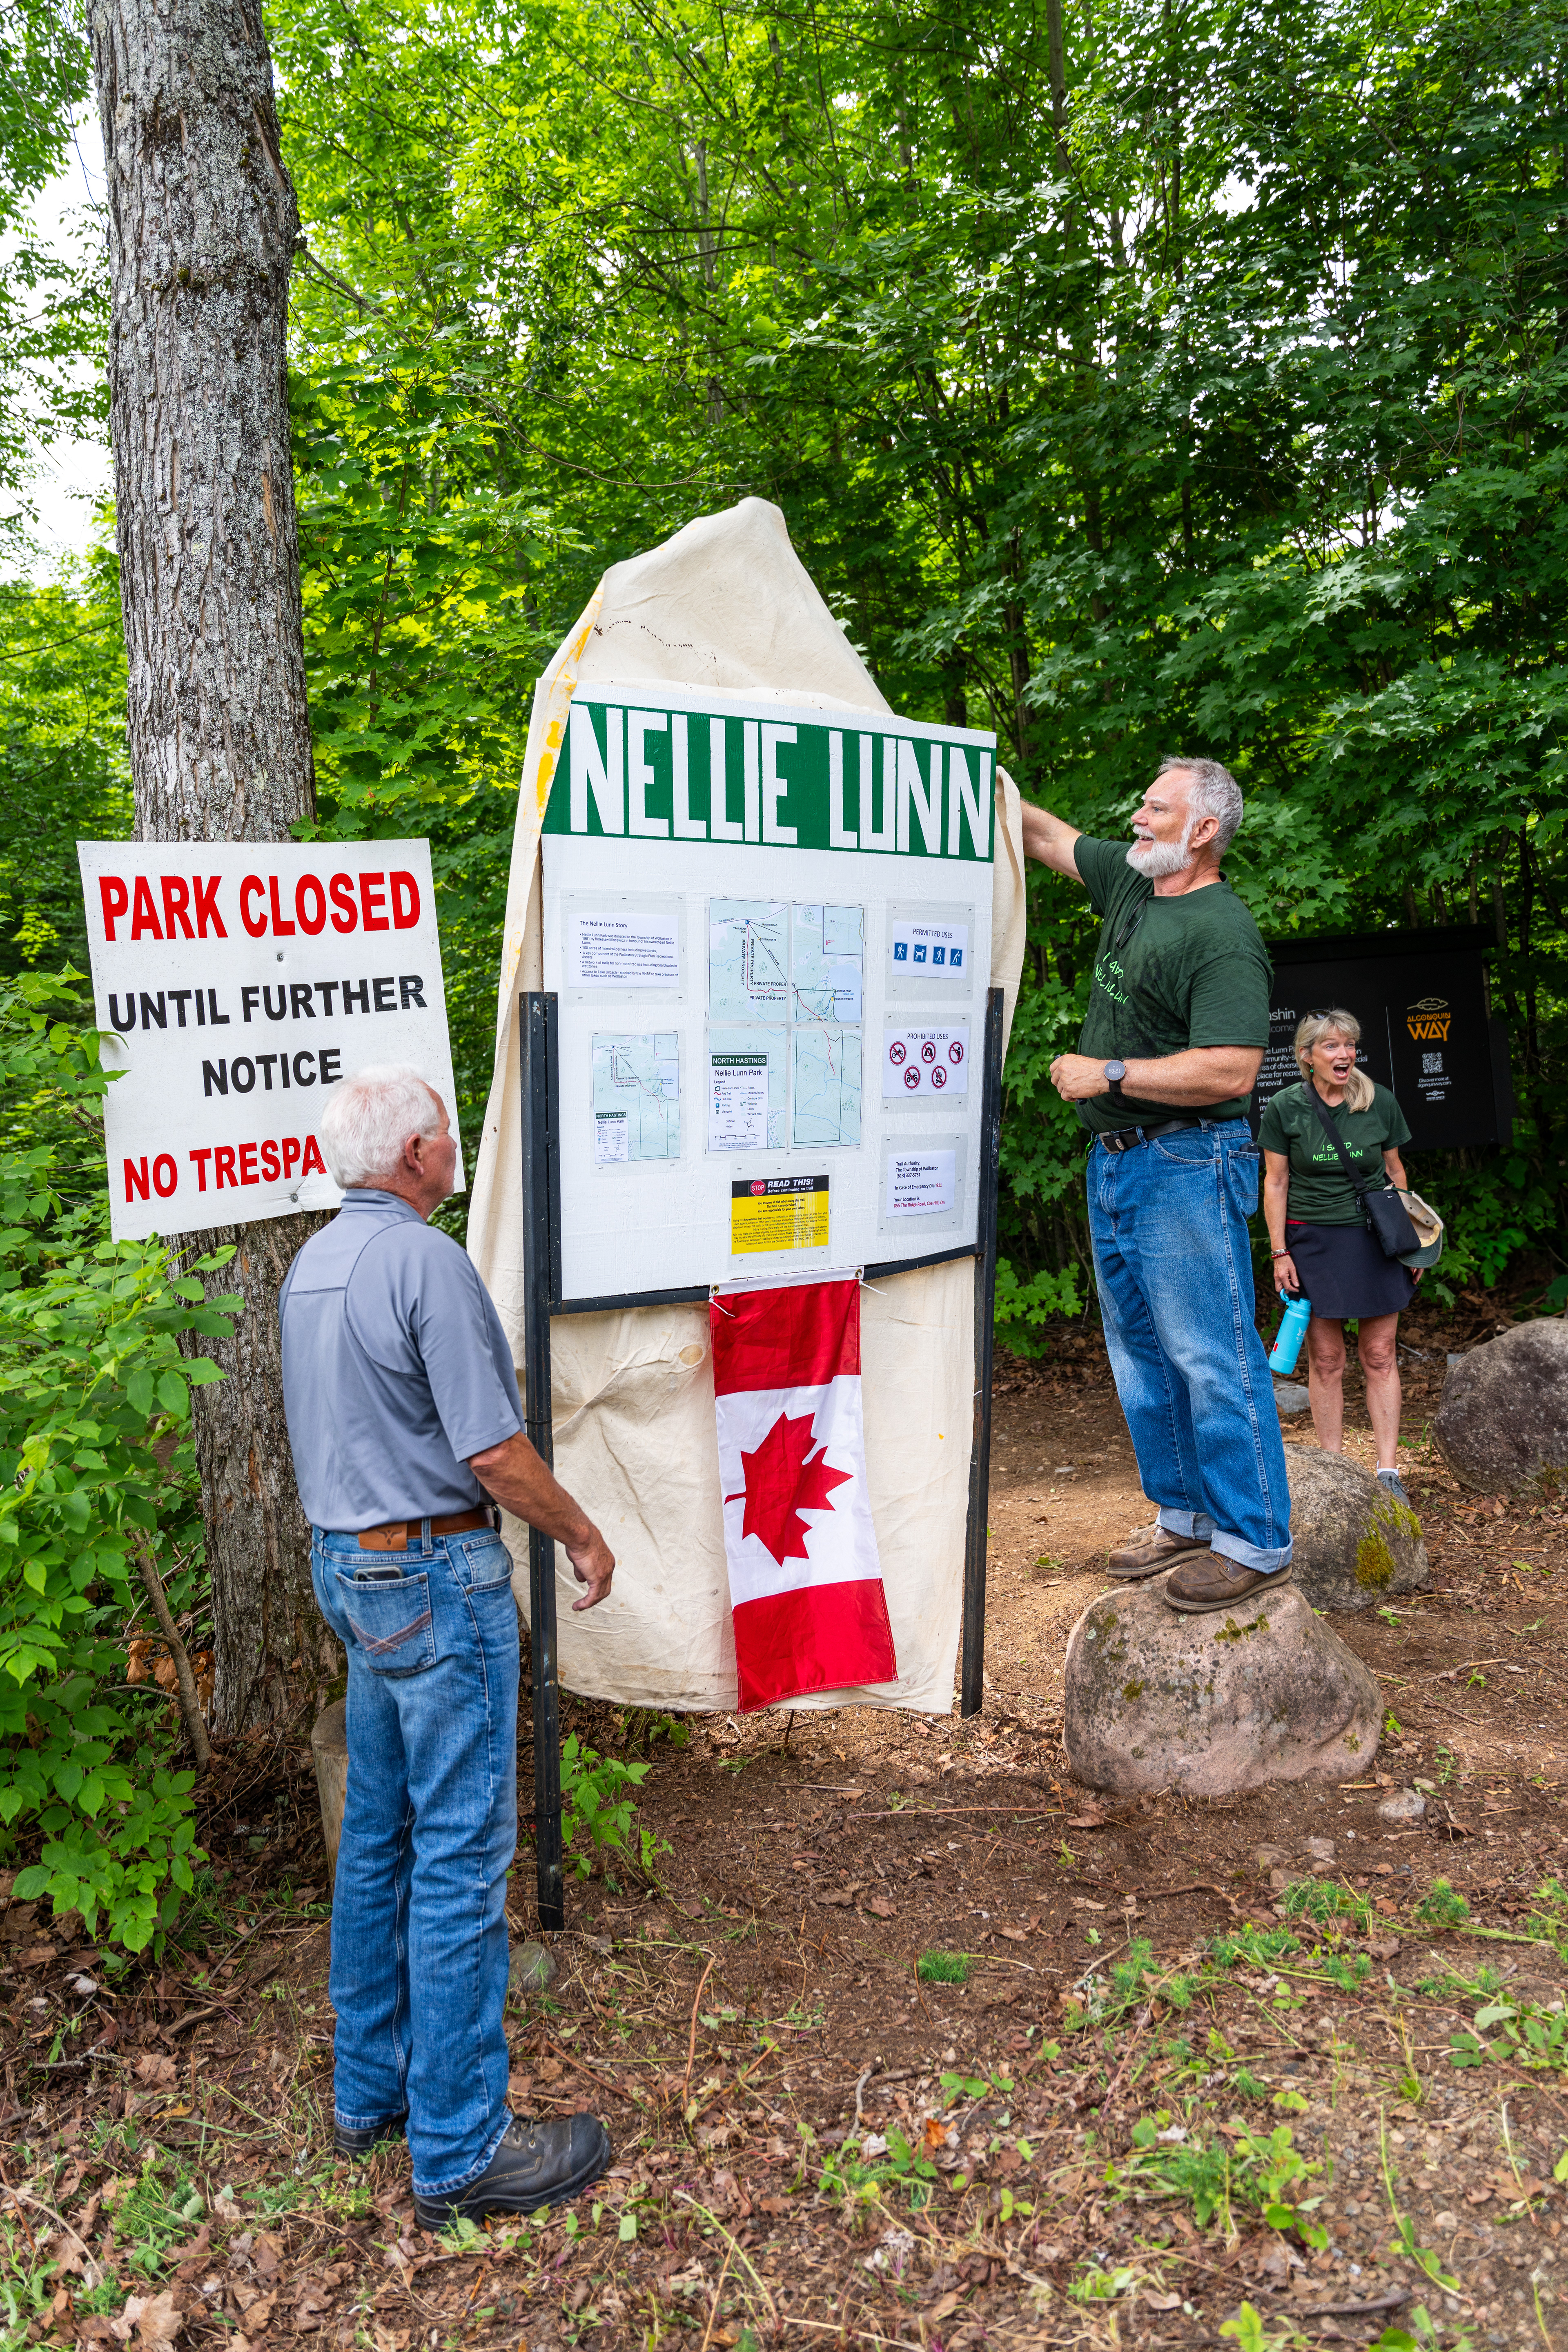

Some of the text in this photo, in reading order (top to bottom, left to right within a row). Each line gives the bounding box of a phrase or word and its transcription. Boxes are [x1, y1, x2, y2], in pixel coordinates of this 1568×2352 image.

[570, 704, 991, 858] NELLIE LUNN
[98, 871, 421, 942] PARK CLOSED
[108, 975, 428, 1032] UNTIL FURTHER
[1407, 1012, 1450, 1022] ALGONQUIN
[1407, 1020, 1451, 1041] WAY
[202, 1048, 343, 1097] NOTICE
[1257, 1071, 1272, 1080] place
[1257, 1079, 1283, 1087] renewal.
[1270, 1062, 1276, 1070] of
[124, 1134, 327, 1203] NO TRESPA
